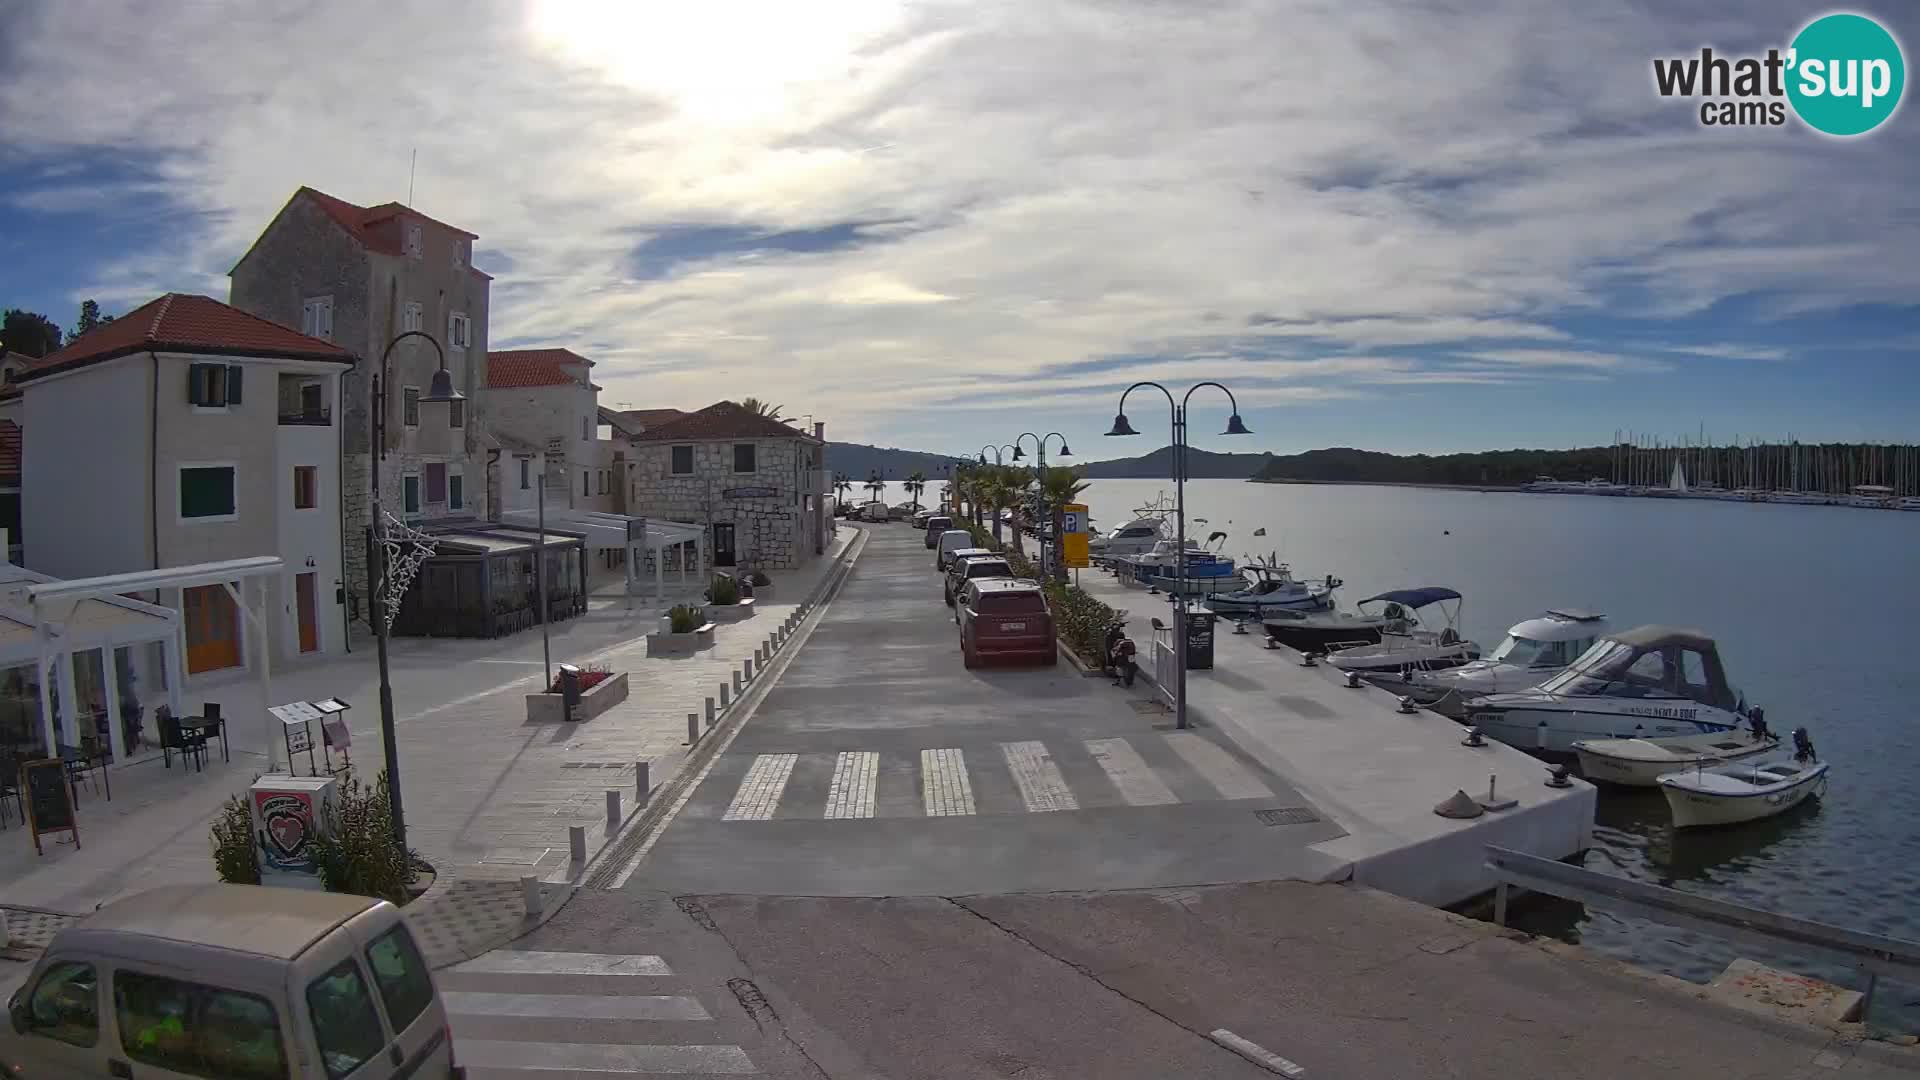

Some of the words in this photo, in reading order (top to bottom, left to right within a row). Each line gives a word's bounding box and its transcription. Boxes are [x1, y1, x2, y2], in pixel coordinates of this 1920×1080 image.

[1065, 514, 1076, 531] P
[1653, 707, 1673, 717] RENT
[1679, 708, 1698, 720] BOAT
